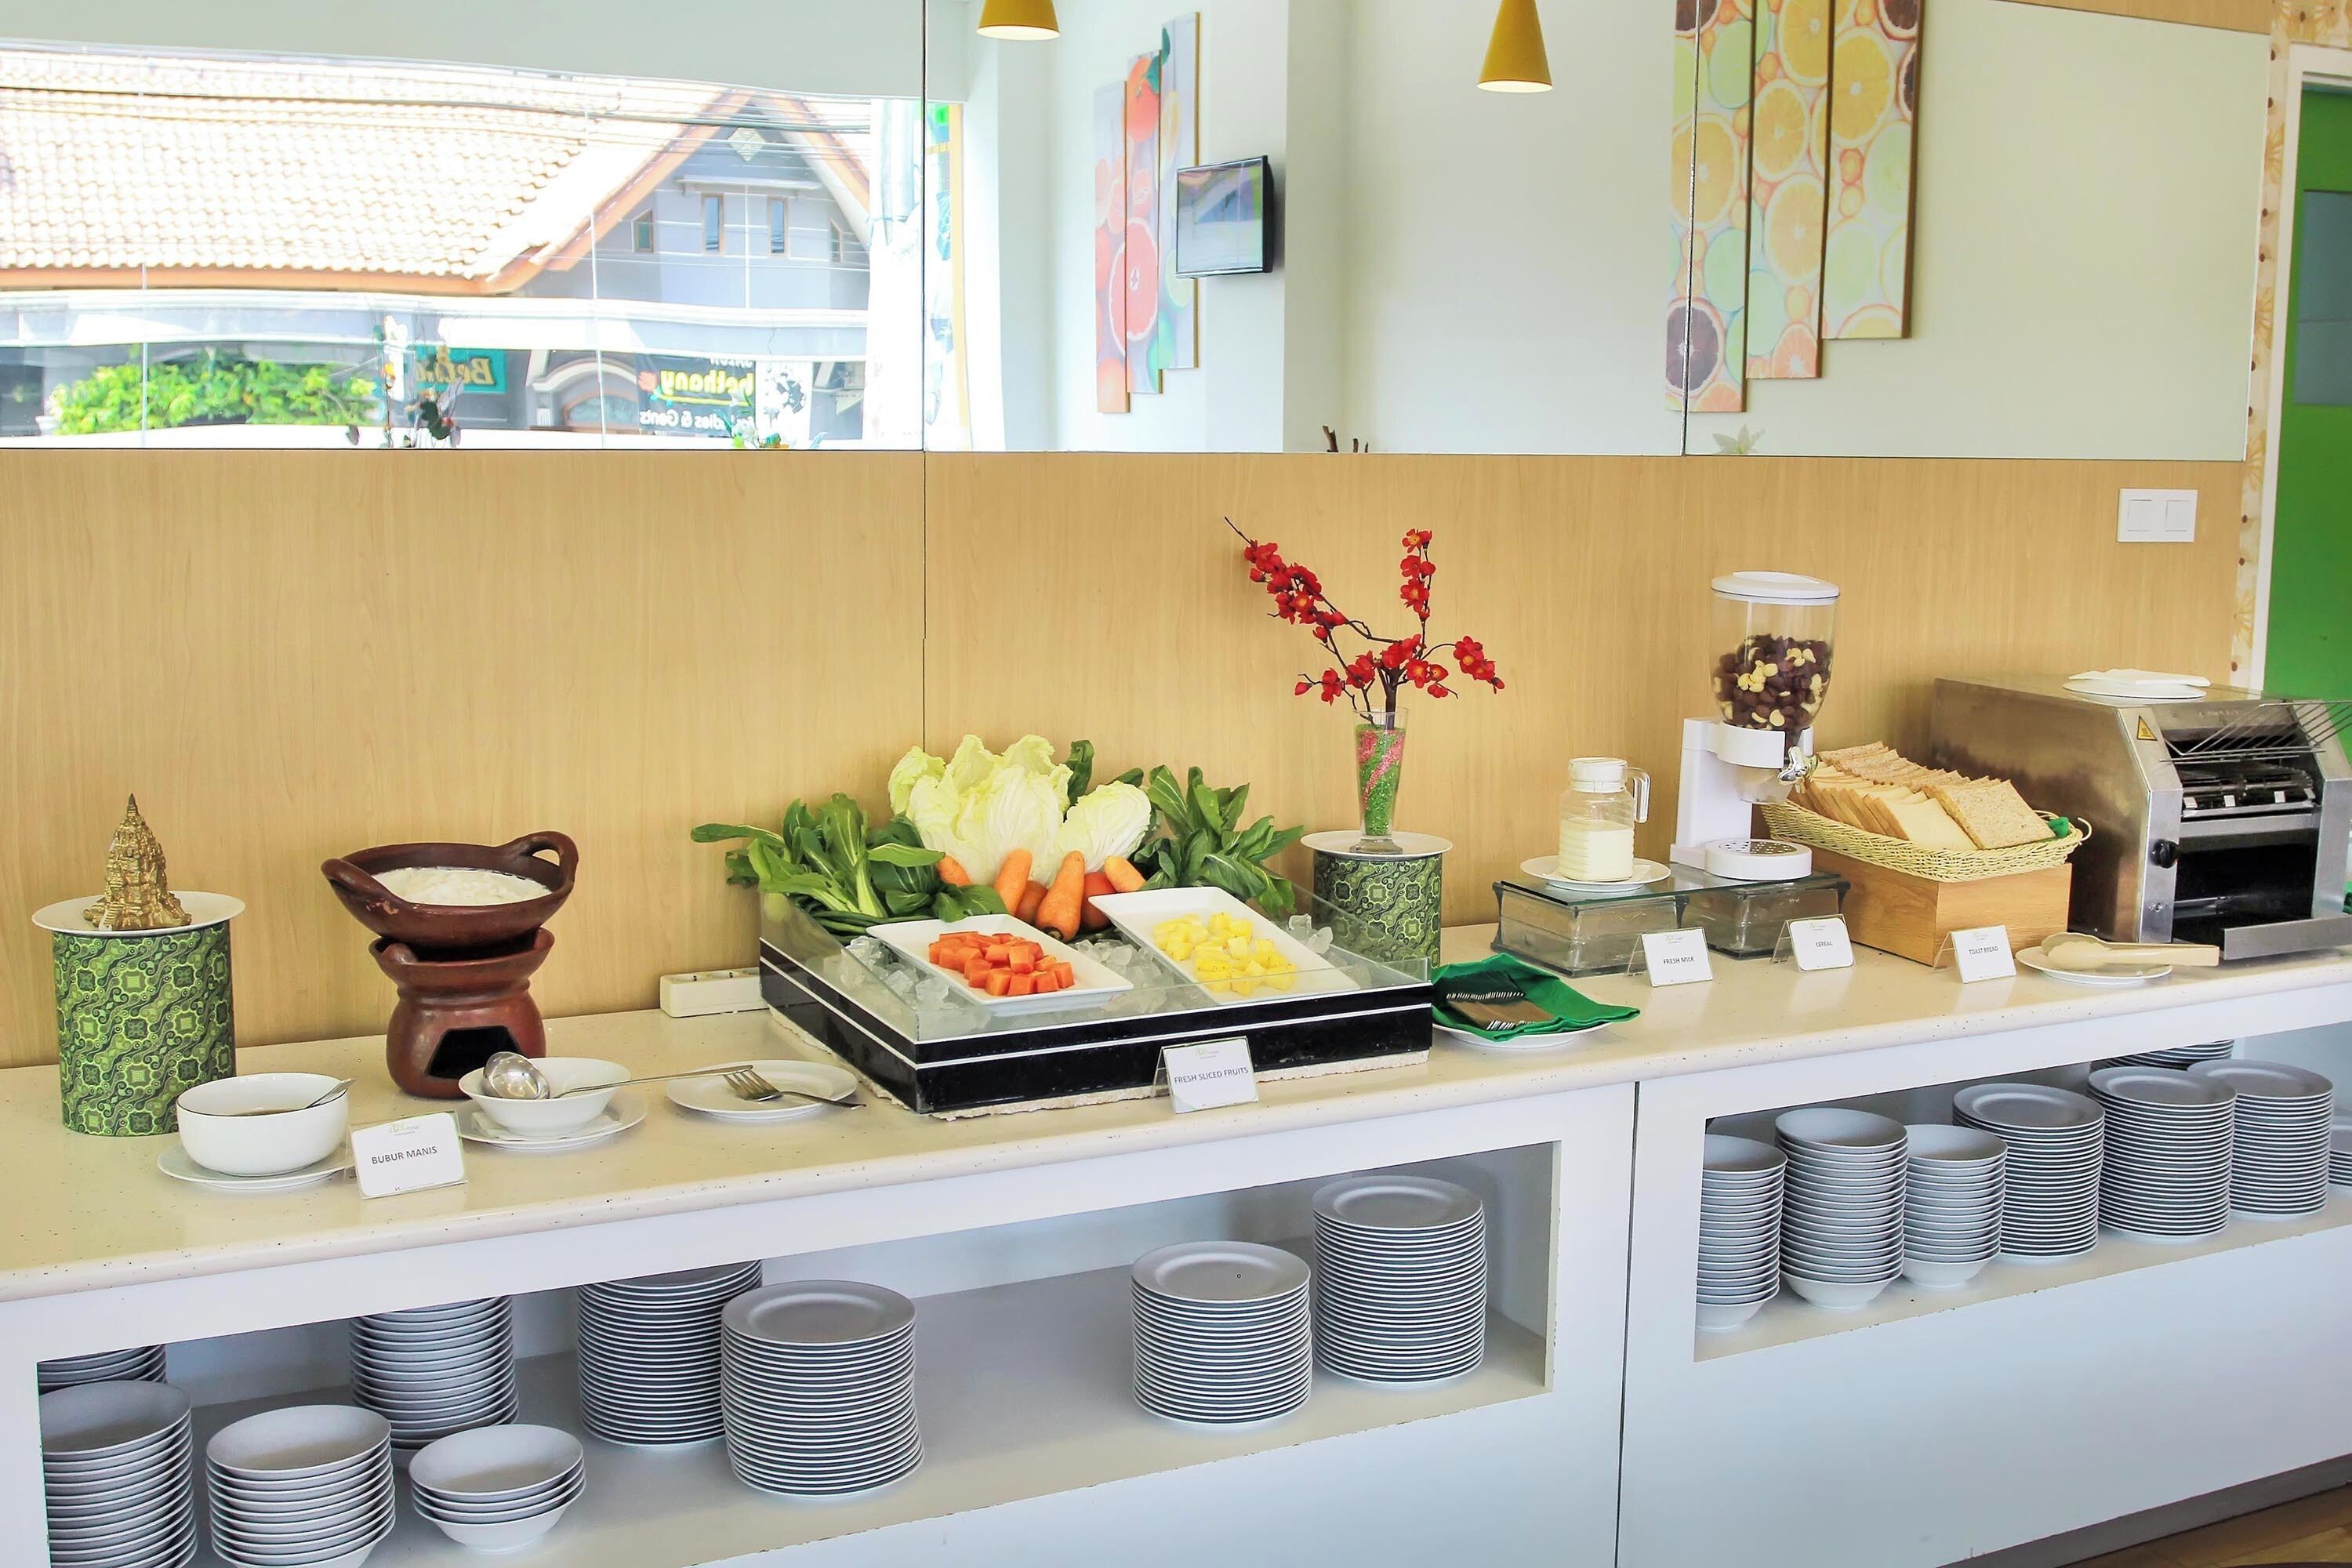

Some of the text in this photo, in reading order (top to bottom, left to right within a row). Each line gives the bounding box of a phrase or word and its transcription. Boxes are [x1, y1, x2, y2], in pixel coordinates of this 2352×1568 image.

[1174, 1066, 1249, 1084] FRESH SLICED FRUITS
[372, 1145, 437, 1165] BUBUR MANIS
